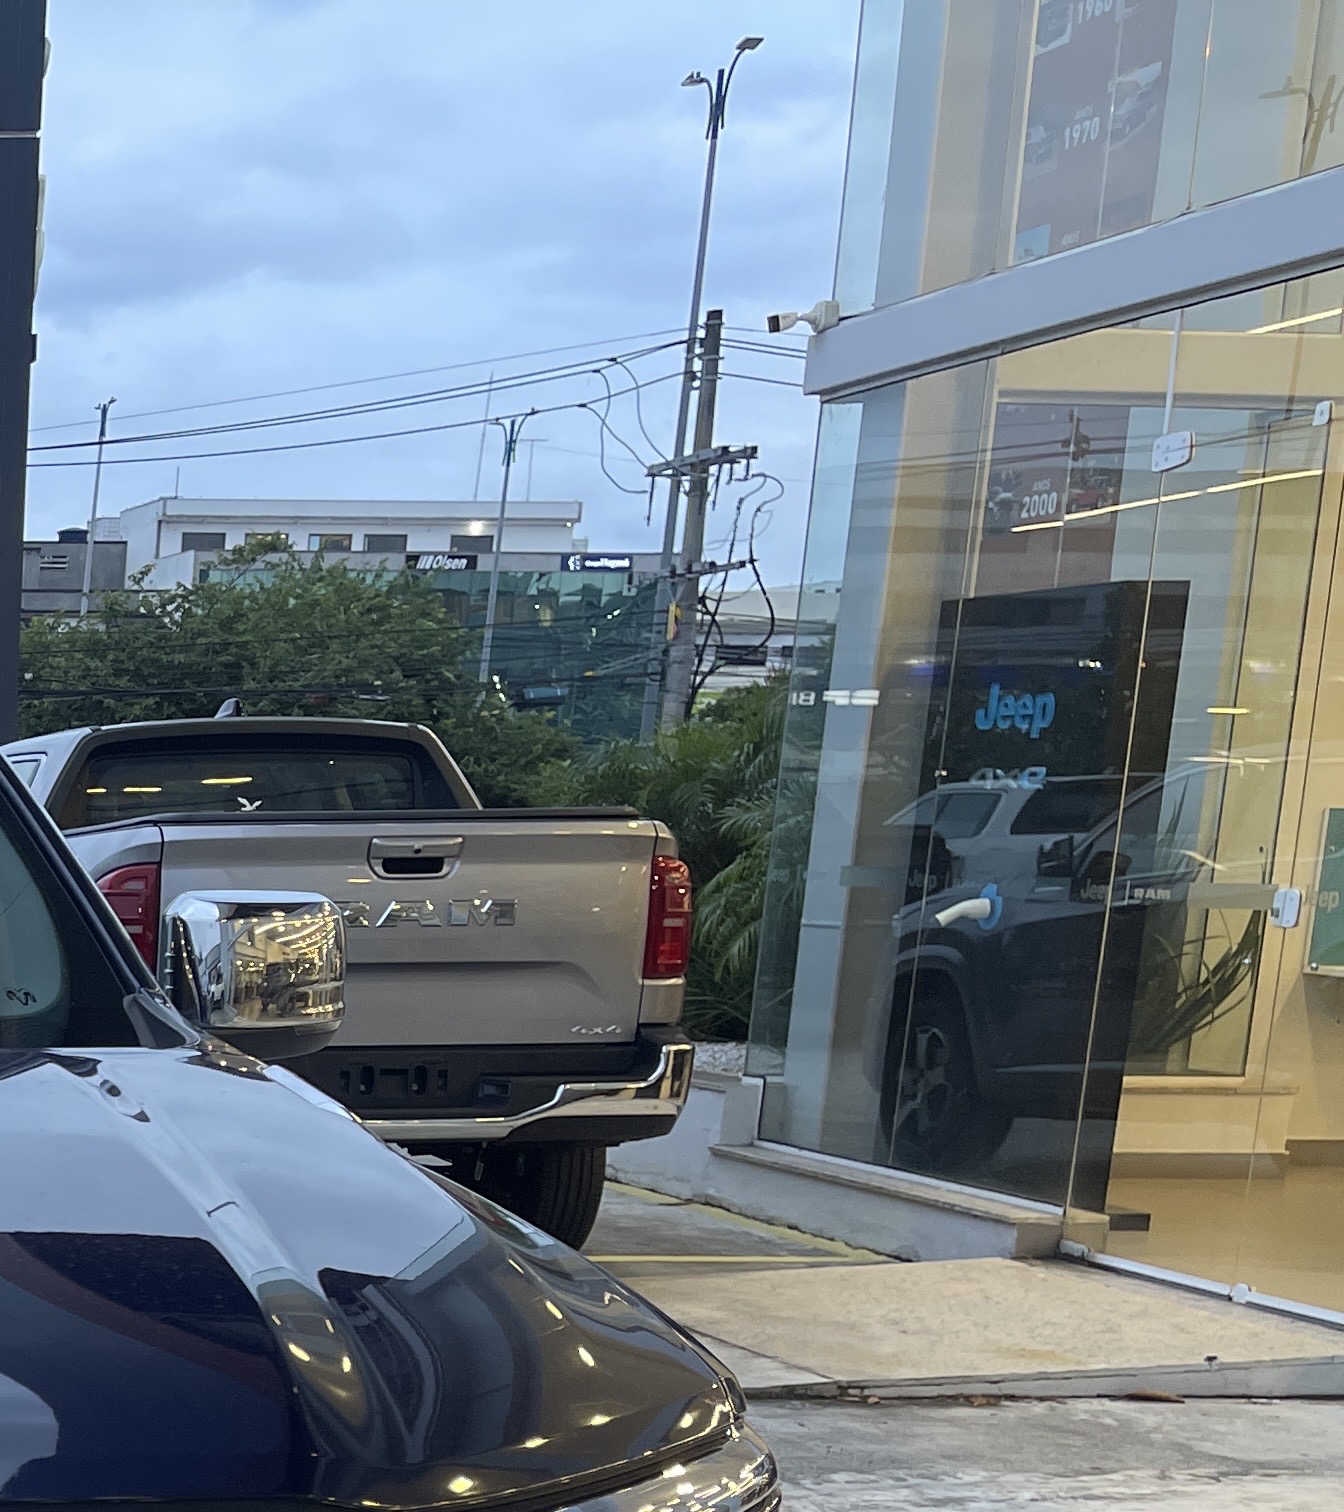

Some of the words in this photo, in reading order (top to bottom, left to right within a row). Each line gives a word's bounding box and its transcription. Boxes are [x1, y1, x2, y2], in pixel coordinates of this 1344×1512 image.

[1064, 117, 1101, 150] 1970
[1020, 492, 1058, 519] 2000
[432, 555, 468, 569] Olsen
[975, 682, 1056, 739] Jeep
[1134, 887, 1171, 900] RAM
